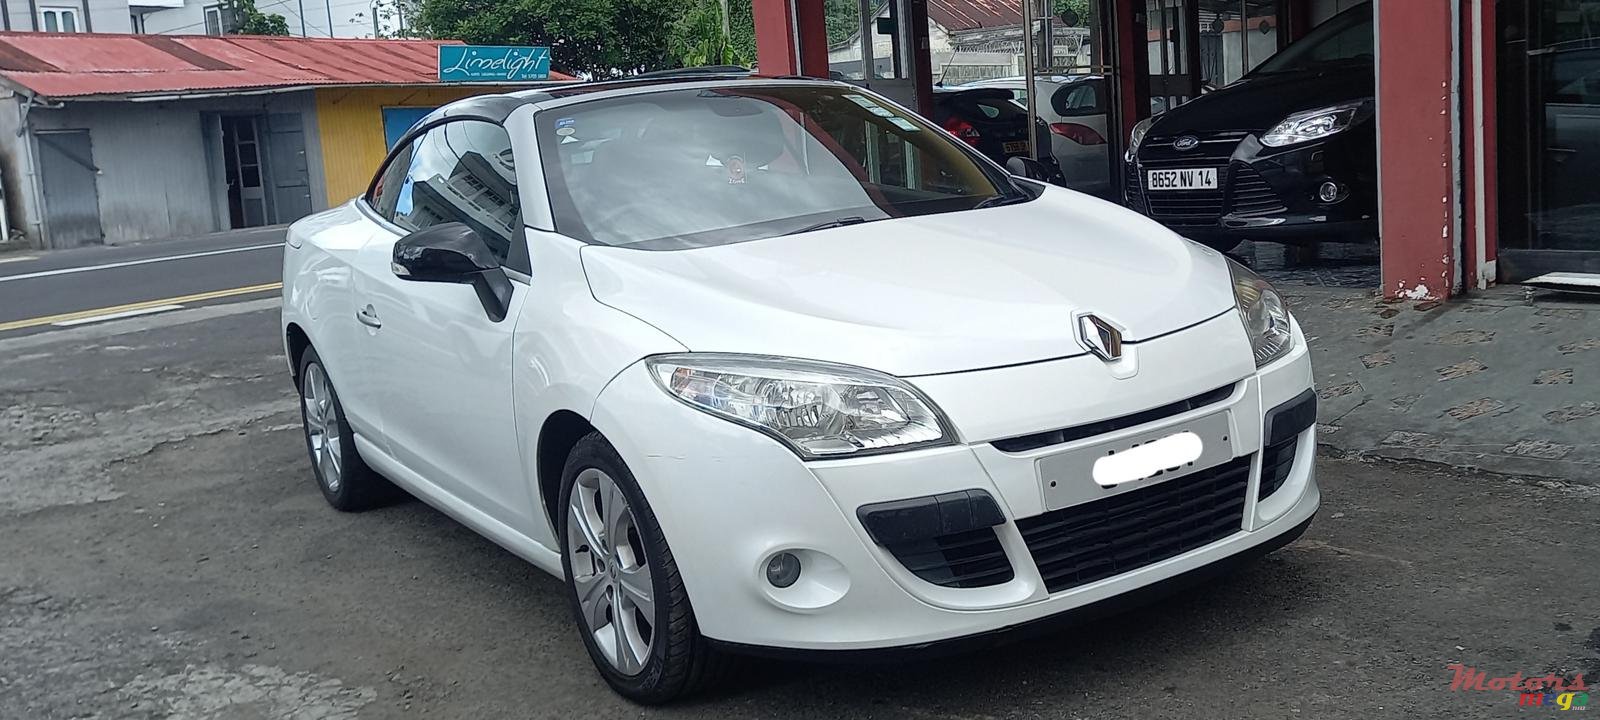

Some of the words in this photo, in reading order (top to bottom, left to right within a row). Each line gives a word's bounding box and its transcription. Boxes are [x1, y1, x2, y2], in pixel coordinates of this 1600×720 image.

[443, 48, 548, 79] Limelight
[1176, 138, 1192, 147] Ford
[1152, 171, 1178, 188] 8652
[1180, 170, 1194, 187] NV
[1198, 170, 1211, 186] 14
